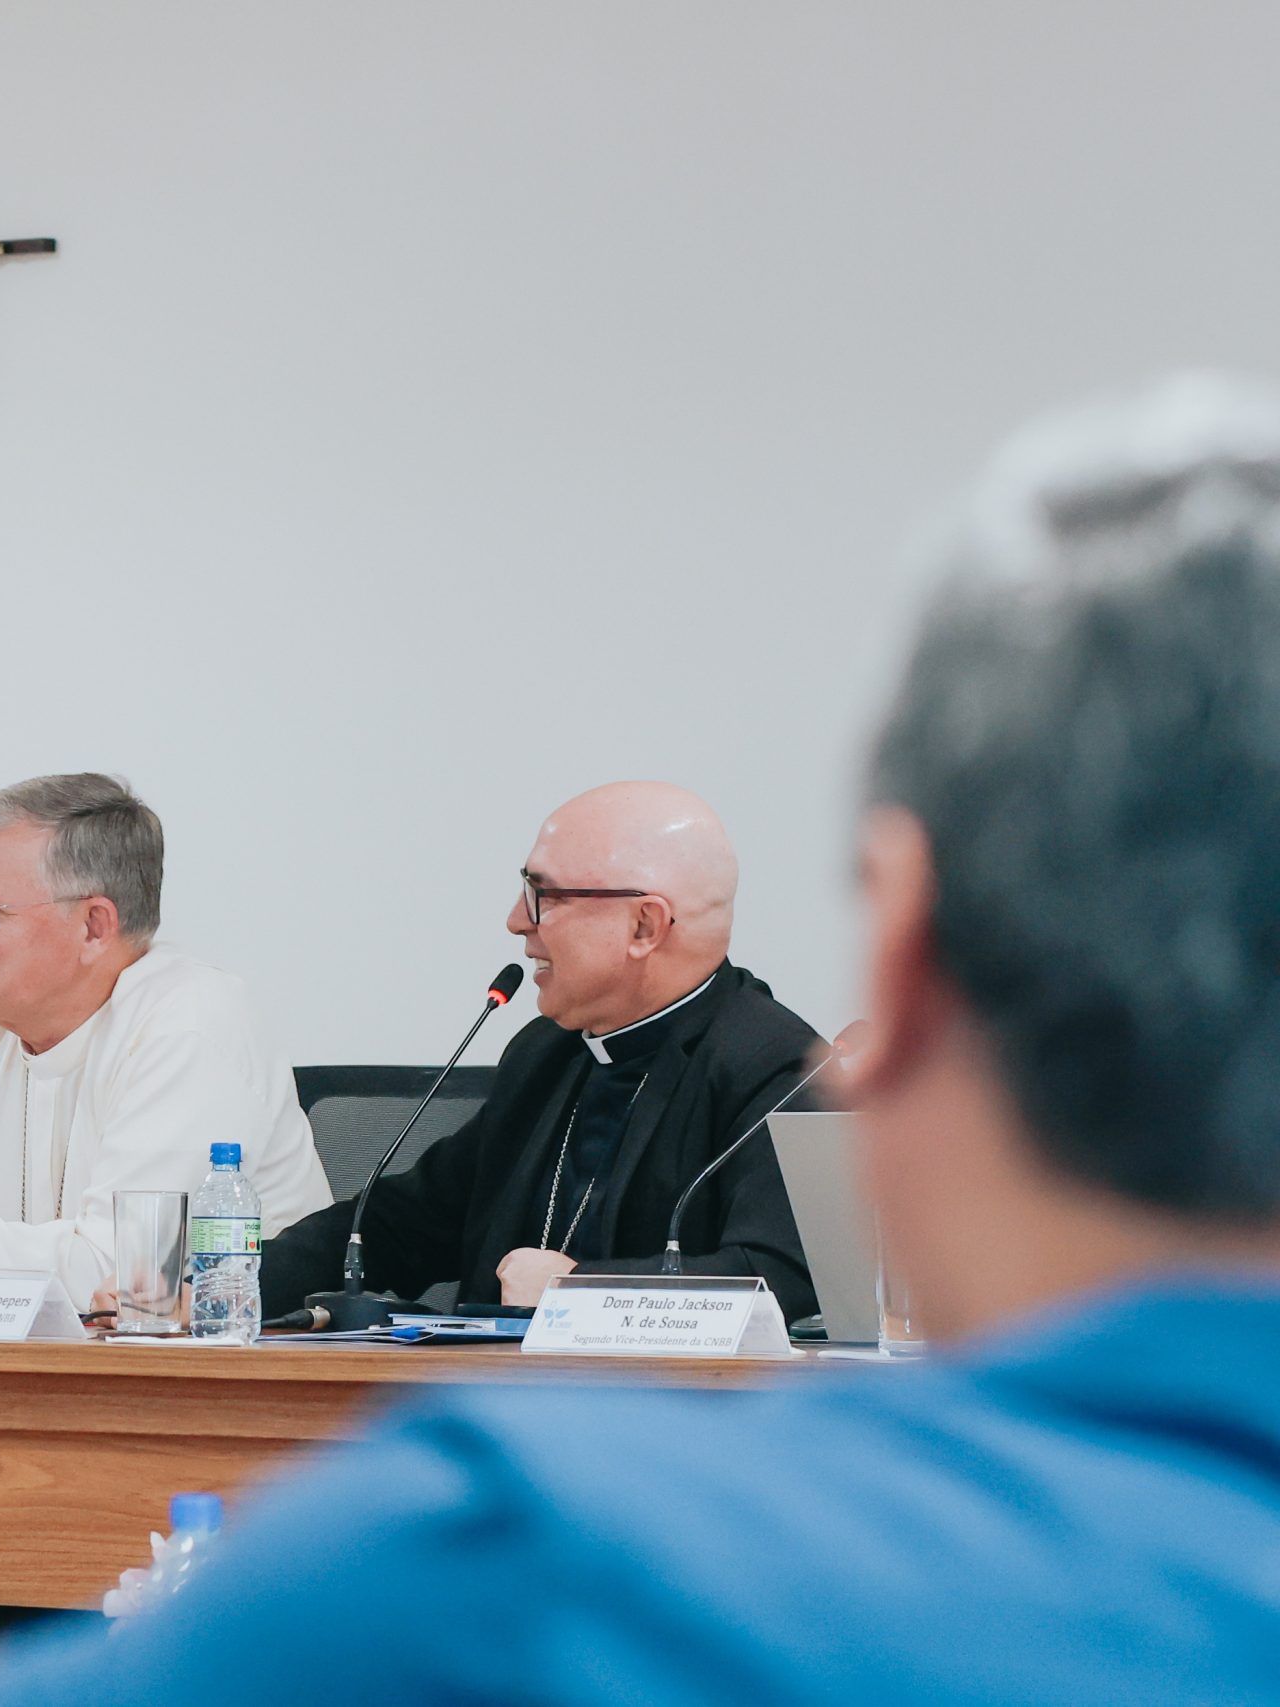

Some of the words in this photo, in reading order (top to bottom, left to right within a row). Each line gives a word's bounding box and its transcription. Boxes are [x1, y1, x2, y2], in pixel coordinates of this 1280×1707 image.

[602, 1296, 633, 1310] Dom
[637, 1296, 676, 1310] Paulo
[678, 1296, 733, 1311] Jackson
[620, 1316, 635, 1328] N.
[639, 1316, 656, 1328] de
[659, 1316, 698, 1329] Sousa
[572, 1334, 613, 1345] Segundo
[615, 1335, 688, 1346] Vice-Presidente
[689, 1336, 702, 1346] da
[704, 1337, 733, 1347] CNBB
